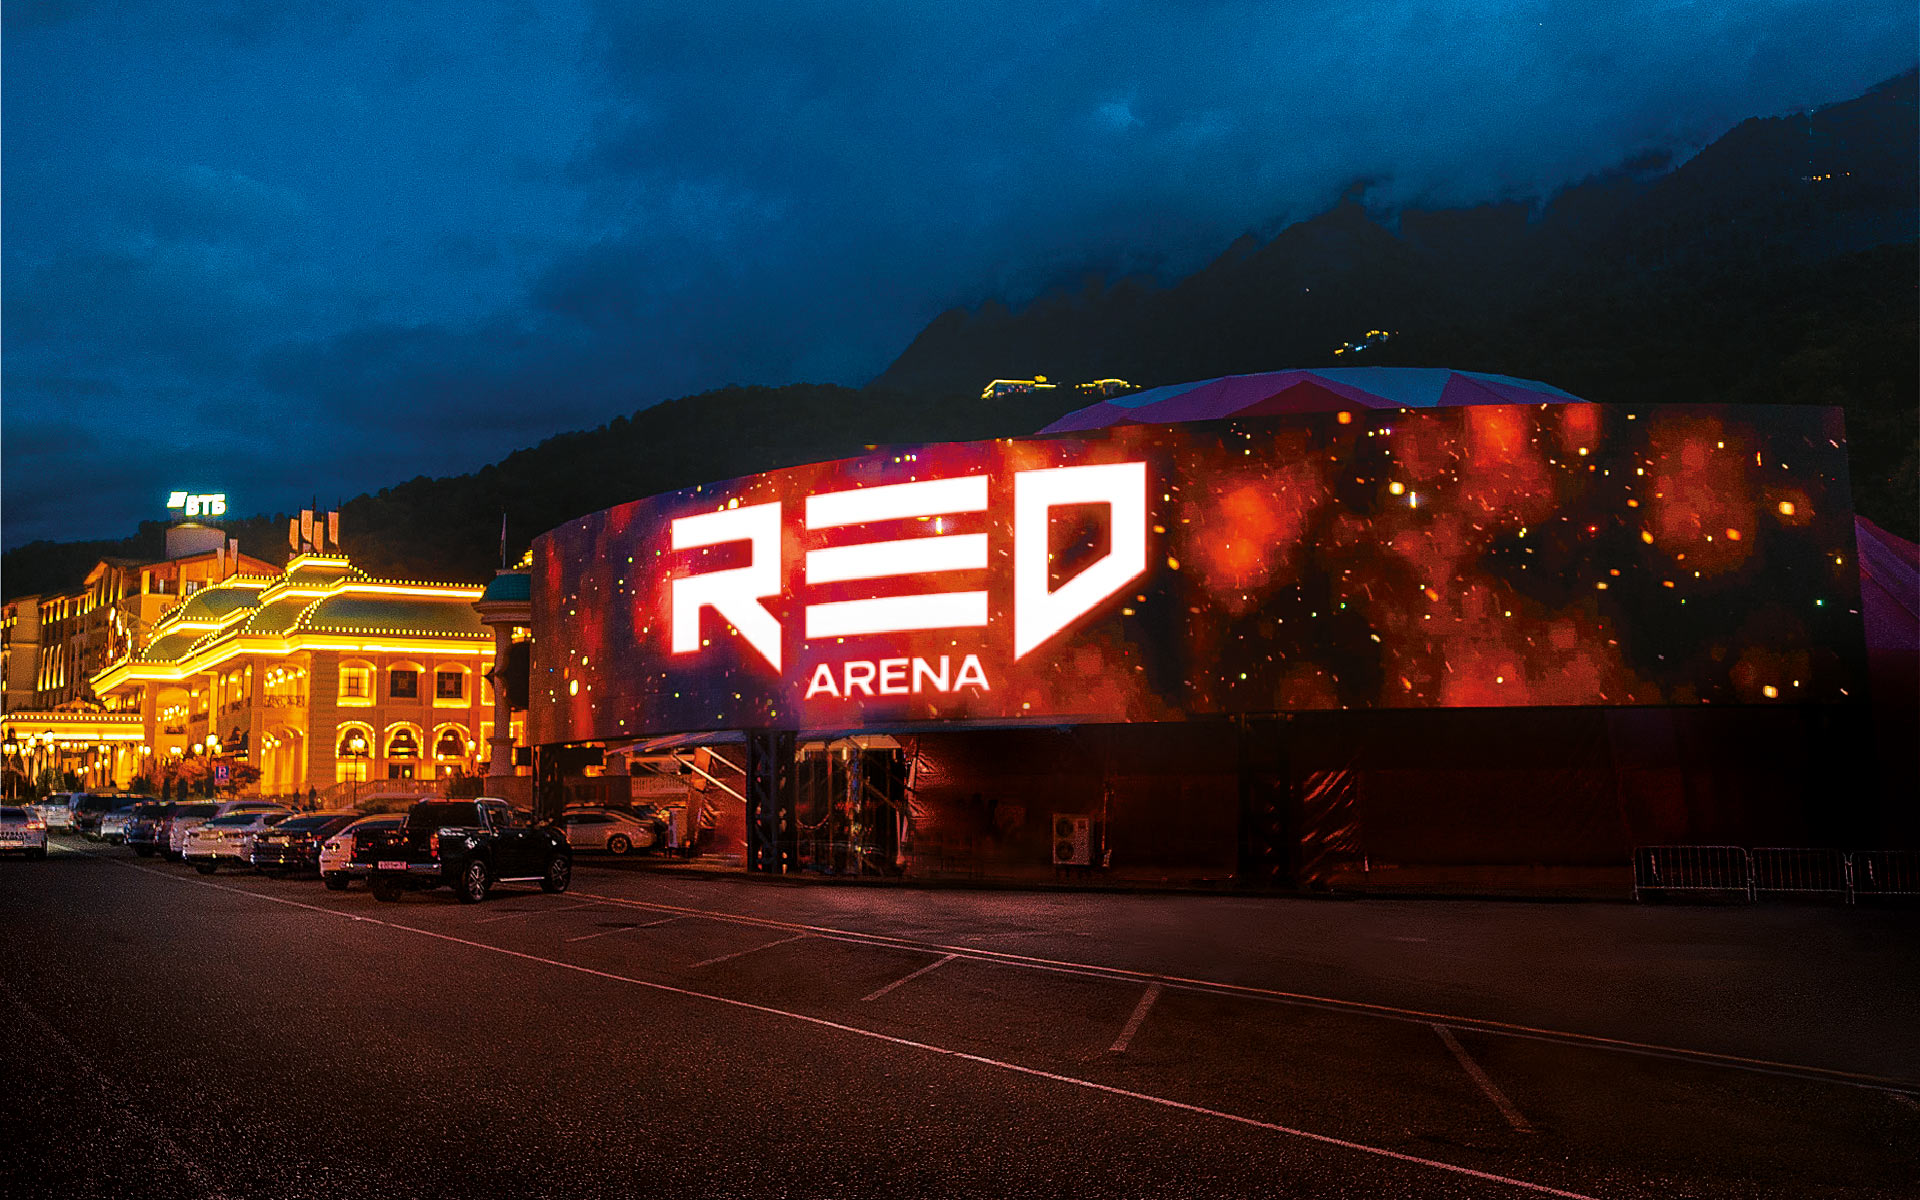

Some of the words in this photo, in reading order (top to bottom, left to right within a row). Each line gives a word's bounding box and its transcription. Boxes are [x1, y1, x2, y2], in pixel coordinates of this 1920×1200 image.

[185, 493, 226, 516] ВТБ
[671, 461, 1147, 675] RED
[804, 653, 991, 700] ARENA
